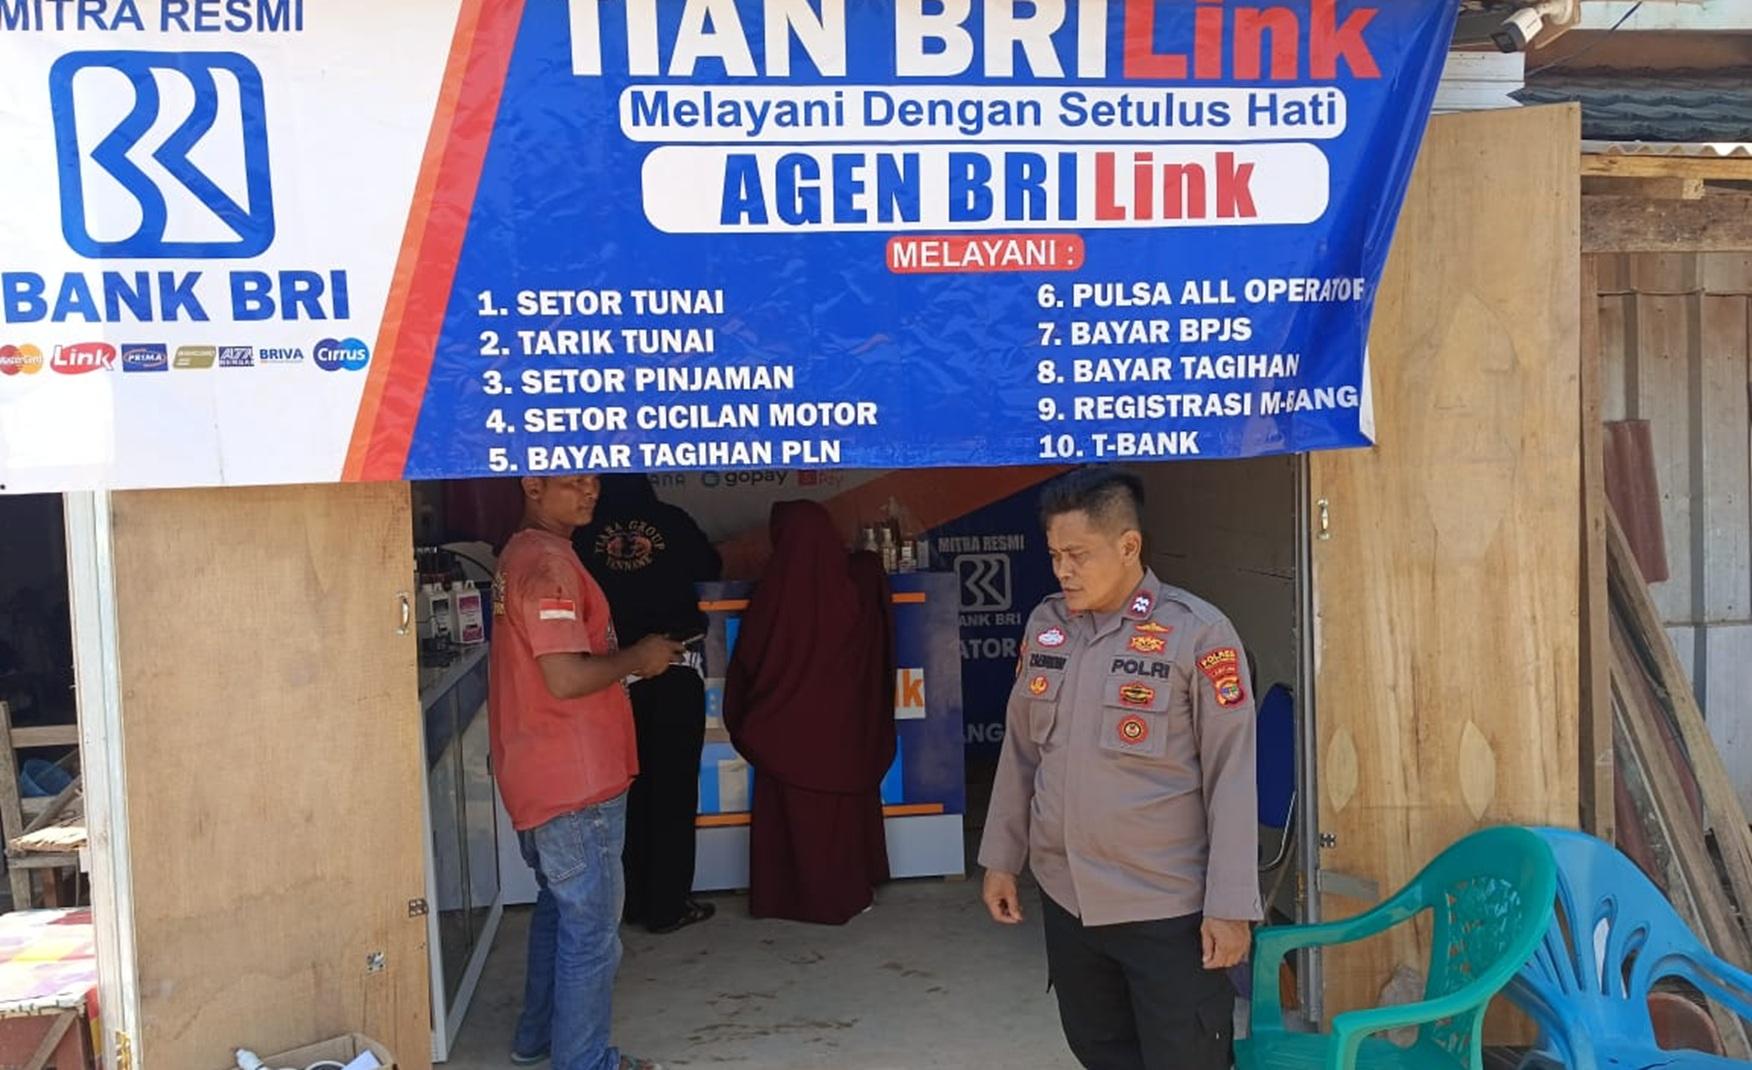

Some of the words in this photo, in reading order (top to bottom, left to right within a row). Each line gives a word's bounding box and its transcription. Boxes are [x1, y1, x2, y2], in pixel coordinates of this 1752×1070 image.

[0, 0, 144, 31] MITRA
[160, 0, 304, 32] RESMI
[630, 90, 844, 137] Melayani
[863, 91, 1041, 137] Dengan
[1059, 92, 1231, 127] Setulus
[1247, 92, 1337, 127] Hati
[719, 152, 920, 226] AGEN
[892, 241, 1056, 269] MELAYANI
[1, 271, 210, 324] BANK
[229, 269, 350, 321] BRI
[478, 290, 508, 316] 1.
[517, 290, 622, 315] SETOR
[631, 289, 723, 314] TUNAI
[1037, 284, 1064, 308] 6.
[1073, 282, 1172, 307] PULSA
[1181, 279, 1236, 305] ALL
[480, 331, 510, 355] 2.
[518, 330, 614, 355] TARIK
[622, 328, 714, 354] TUNAI
[1038, 322, 1062, 346] 7.
[1071, 320, 1170, 345] BAYAR
[1180, 317, 1252, 342] BPJS
[53, 344, 114, 371] Link
[127, 354, 162, 362] PRIMA
[260, 349, 304, 361] BRIVA
[317, 347, 366, 362] Cirrus
[1037, 360, 1064, 384] 8.
[1073, 358, 1172, 383] BAYAR
[1180, 353, 1300, 380] TAGIHAN
[483, 370, 513, 394] 3.
[521, 369, 625, 394] SETOR
[635, 366, 794, 392] PINJAMAN
[486, 409, 515, 433] 4.
[524, 407, 627, 432] SETOR
[637, 404, 759, 430] CICILAN
[769, 402, 877, 428] MOTOR
[1038, 397, 1065, 421] 9.
[1074, 392, 1252, 420] REGISTRASI
[489, 447, 518, 472] 5.
[528, 445, 631, 470] BAYAR
[640, 441, 774, 467] TAGIHAN
[783, 440, 841, 463] PLN
[1039, 434, 1084, 458] 10.
[1092, 431, 1200, 457] T-BANK
[724, 470, 788, 487] gopay
[938, 536, 980, 552] MITRA
[982, 534, 1024, 551] RESMI
[959, 615, 991, 627] ANK
[995, 613, 1021, 625] BRI
[1111, 659, 1170, 679] POLRI
